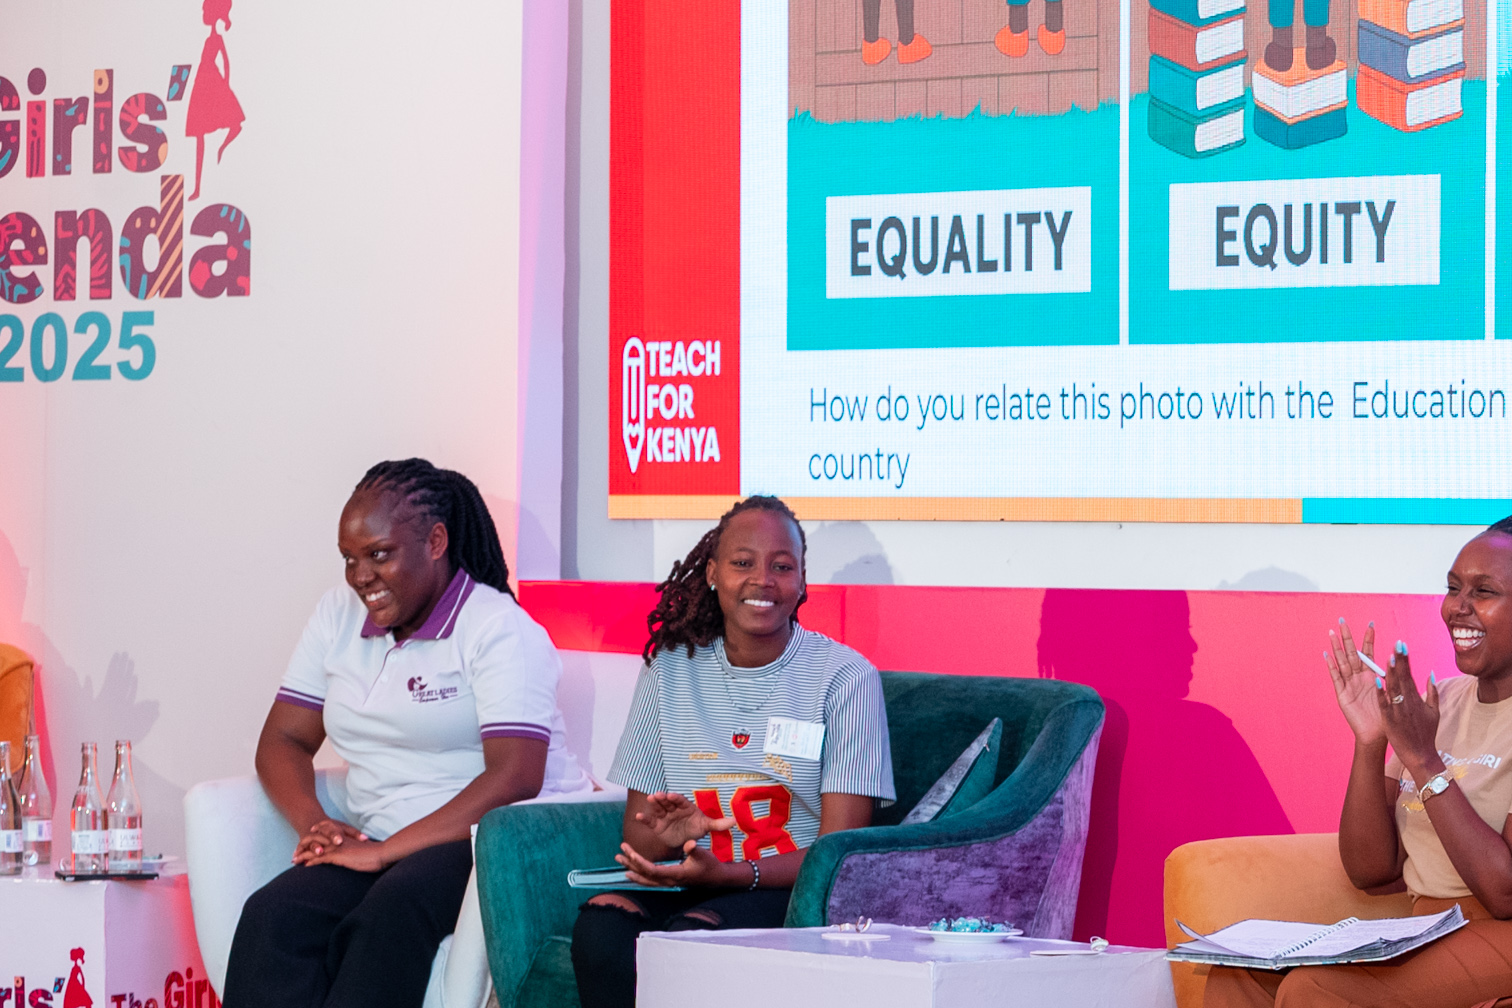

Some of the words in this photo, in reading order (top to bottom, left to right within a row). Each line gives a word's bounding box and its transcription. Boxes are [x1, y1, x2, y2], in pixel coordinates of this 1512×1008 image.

[0, 174, 251, 304] enda
[850, 210, 1073, 280] EQUALITY
[1215, 199, 1397, 270] EQUITY
[0, 310, 157, 383] 2025
[646, 339, 722, 377] TEACH
[647, 384, 695, 420] FOR
[809, 385, 868, 422] How
[875, 384, 910, 421] do
[915, 393, 966, 430] you
[974, 383, 1052, 420] relate
[1058, 382, 1111, 420] this
[1120, 382, 1204, 428] photo
[1211, 380, 1275, 419] with
[1284, 380, 1334, 419] the
[1352, 379, 1507, 419] Education
[646, 426, 722, 463] KENYA
[808, 449, 911, 489] country
[692, 784, 799, 863] 18
